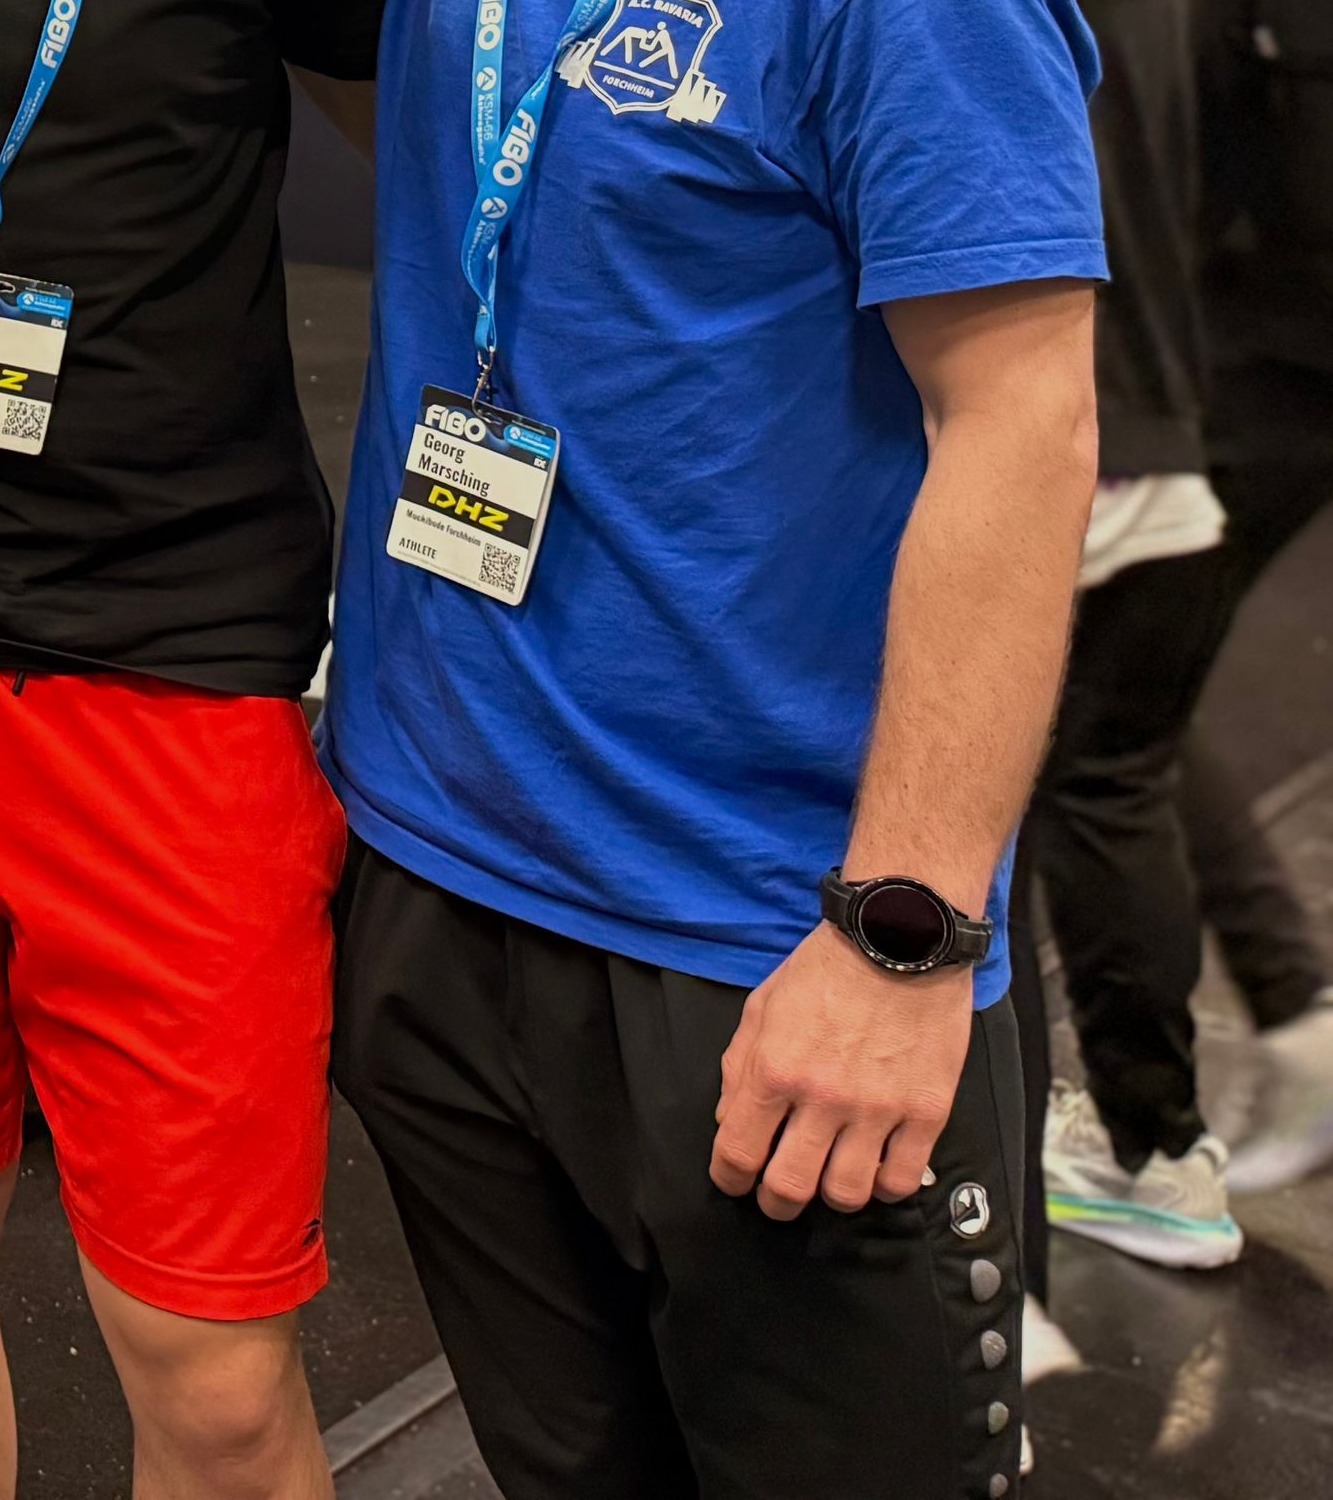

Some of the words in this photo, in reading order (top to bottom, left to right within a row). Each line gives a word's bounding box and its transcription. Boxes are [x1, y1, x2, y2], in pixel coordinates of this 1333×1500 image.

[653, 0, 704, 28] BAVARIA
[603, 75, 654, 98] FORCHHEIM
[483, 93, 494, 141] KSM-66
[492, 108, 536, 187] FIBO
[424, 404, 486, 443] FIBO
[424, 432, 465, 464] Georg
[418, 453, 491, 496] Marsching
[428, 485, 509, 532] DHZ
[399, 537, 437, 559] ATHLETE
